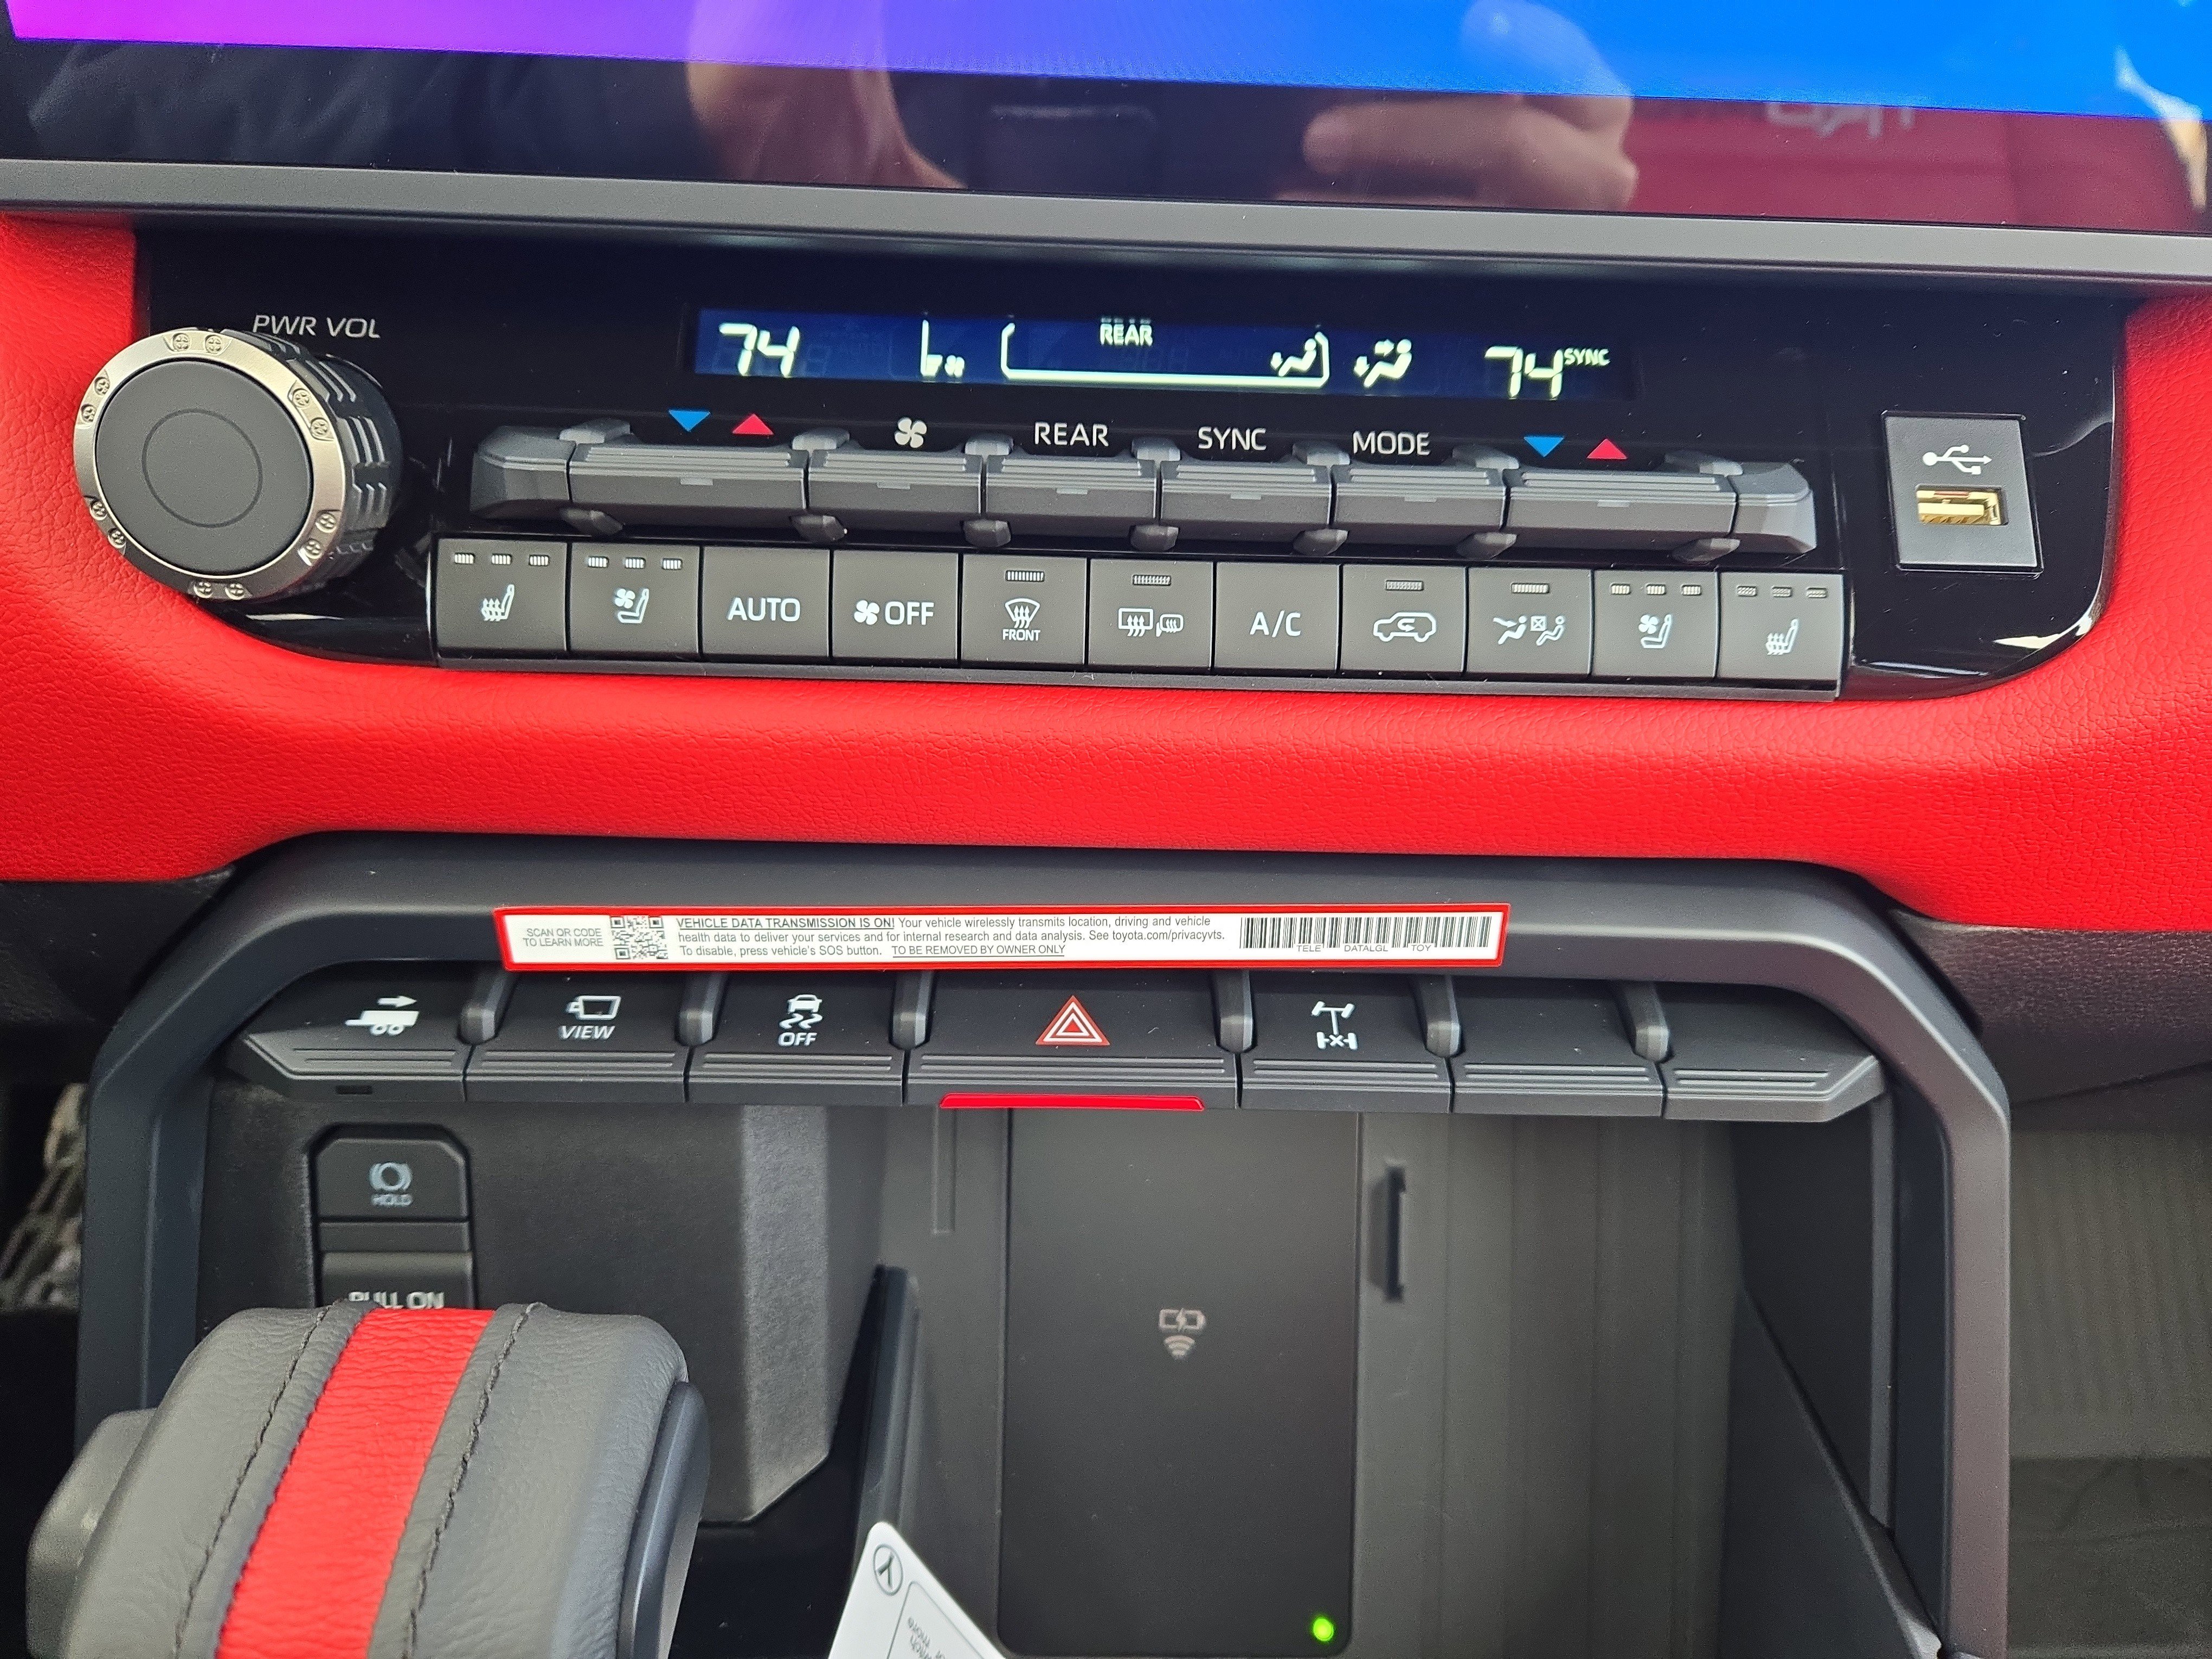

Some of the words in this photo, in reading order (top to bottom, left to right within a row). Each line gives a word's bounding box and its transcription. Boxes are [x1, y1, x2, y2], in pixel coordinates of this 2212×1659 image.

[253, 314, 317, 336] PWR
[326, 317, 381, 338] VOL
[1099, 323, 1153, 346] REAR
[719, 323, 800, 376] 74
[1484, 345, 1564, 399] 74
[1564, 347, 1611, 366] SYNC
[1034, 422, 1109, 447] REAR
[1198, 428, 1266, 452] SYNC
[1353, 432, 1431, 455] MODE
[728, 598, 801, 622] AUTO
[884, 601, 935, 626] OFF
[1002, 629, 1041, 642] FRONT
[1250, 610, 1301, 638] A/C
[527, 928, 554, 937] SCAN
[574, 928, 602, 937] CODE
[676, 918, 728, 928] VEHICLE
[732, 918, 762, 928] DATA
[766, 918, 856, 928] TRANSMISSION
[860, 918, 870, 928] IS
[874, 917, 895, 928] ON!
[898, 917, 922, 928] Your
[925, 917, 961, 928] vehicle
[964, 917, 1015, 929] wirelessly
[1019, 917, 1065, 927] transmits
[1069, 916, 1111, 928] location,
[1115, 916, 1148, 929] driving
[1152, 916, 1171, 926] and
[1175, 916, 1211, 926] vehicle
[523, 938, 537, 947] TO
[539, 938, 572, 947] LEARN
[574, 938, 603, 947] MORE
[678, 932, 710, 942] health
[714, 932, 736, 942] data
[741, 932, 750, 942] to
[754, 932, 789, 942] deliver
[792, 934, 815, 944] your
[818, 931, 861, 942] services
[864, 931, 883, 942] and
[886, 931, 901, 942] for
[904, 931, 941, 942] internal
[946, 931, 989, 941] research
[993, 931, 1012, 941] and
[1015, 931, 1038, 941] data
[1041, 930, 1085, 943] analysis.
[1089, 930, 1109, 940] See
[1113, 929, 1225, 942] toyota.com/privacyvts.
[679, 946, 693, 955] To
[696, 946, 737, 957] disable,
[740, 948, 768, 958] press
[771, 946, 816, 955] vehicle's
[819, 946, 843, 955] SOS
[847, 946, 882, 955] button.
[891, 946, 906, 955] TO
[909, 946, 922, 954] BE
[925, 946, 978, 954] REMOVED
[980, 945, 994, 954] BY
[996, 945, 1036, 954] OWNER
[1038, 944, 1066, 954] ONLY
[558, 1025, 615, 1040] VIEW
[778, 1032, 818, 1046] OFF
[407, 1291, 445, 1309] ON
